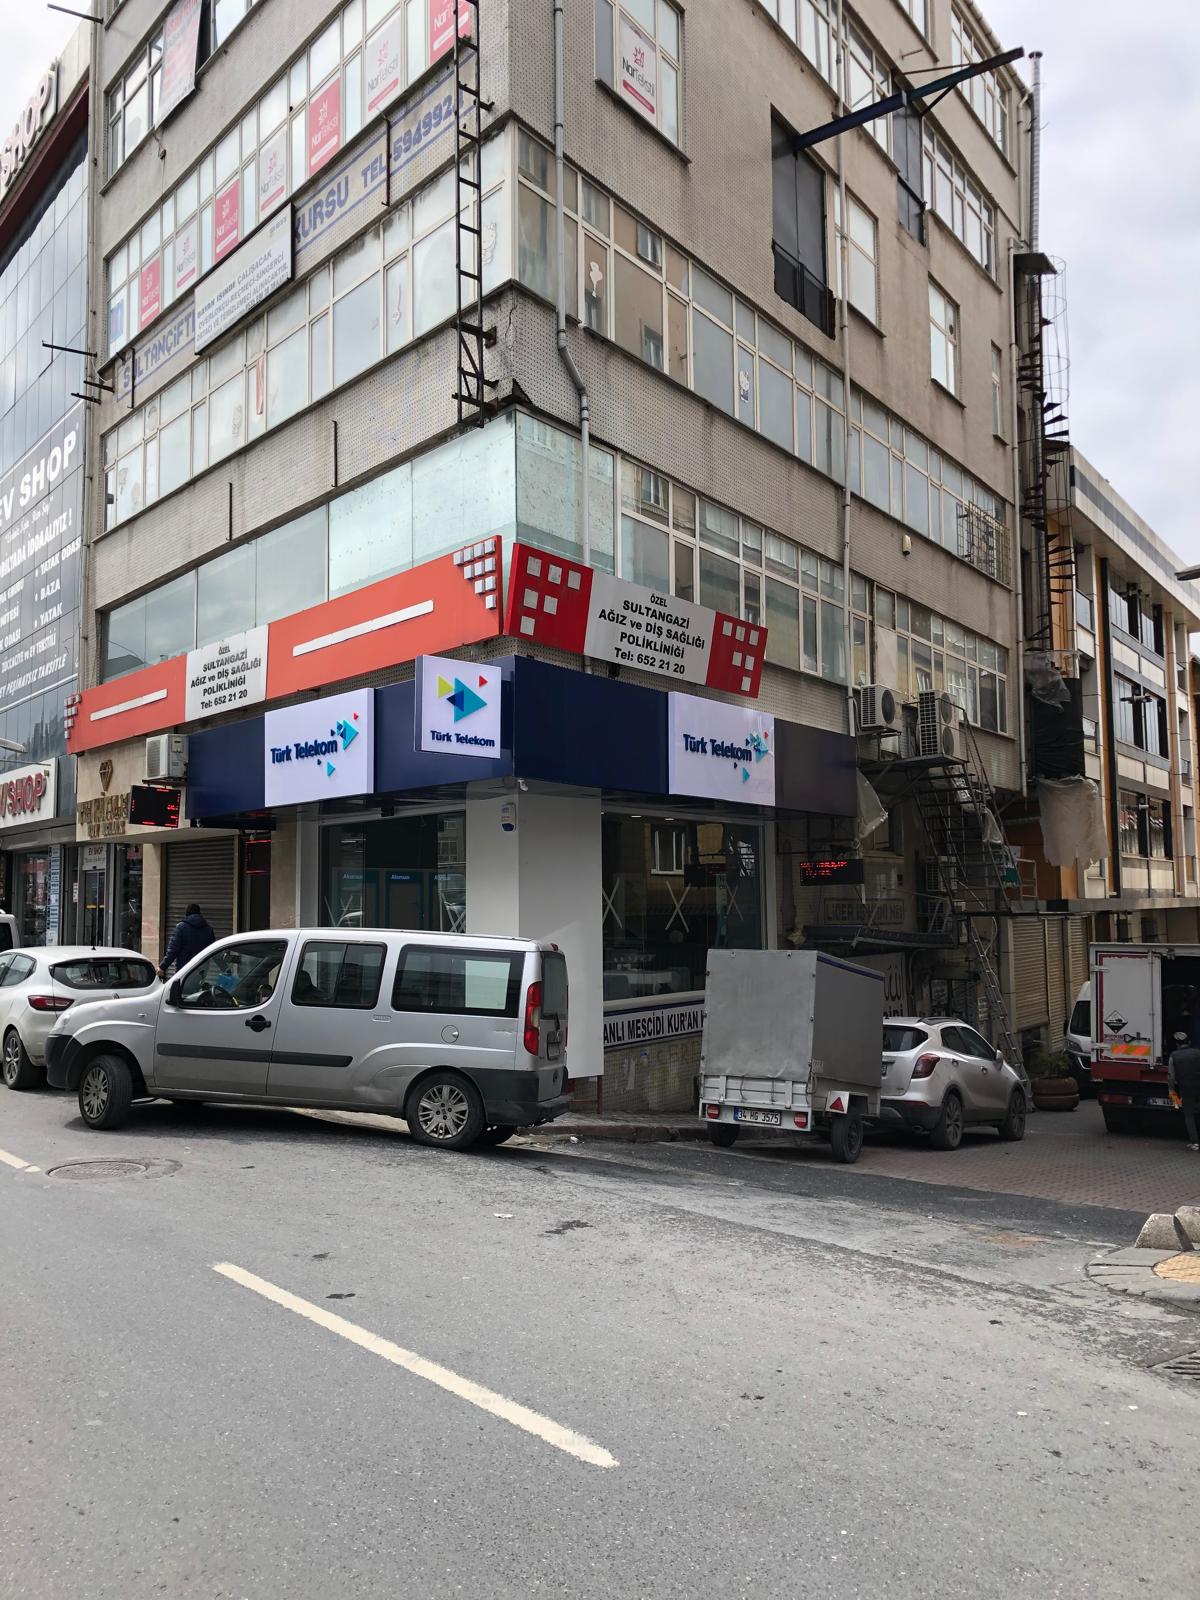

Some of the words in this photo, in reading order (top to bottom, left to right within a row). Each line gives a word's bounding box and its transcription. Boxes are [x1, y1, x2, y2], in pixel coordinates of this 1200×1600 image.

[621, 56, 655, 97] NarTekstil
[0, 487, 14, 528] V
[20, 430, 76, 507] SHOP
[40, 578, 60, 600] BAZA
[649, 593, 667, 607] ÖZEL
[40, 602, 63, 627] YATAK
[623, 600, 689, 629] SULTANGAZİ
[599, 609, 627, 626] AĞIZ
[630, 620, 642, 630] ve
[645, 622, 663, 638] DİŞ
[666, 629, 705, 649] SAĞLIĞI
[218, 645, 230, 655] ÖZEL
[620, 632, 684, 659] POLİKLİNİĞİ
[191, 676, 206, 688] AĞIZ
[217, 667, 229, 680] DİŞ
[231, 655, 261, 675] SAĞLIĞI
[203, 648, 247, 672] SULTANGAZİ
[614, 647, 633, 661] Tel:
[637, 653, 656, 667] 652
[658, 660, 670, 671] 21
[673, 663, 685, 674] 20
[203, 675, 245, 696] POLİKLİNİĞİ
[201, 700, 212, 710] Tel:
[214, 695, 226, 706] 652
[228, 692, 236, 702] 21
[238, 689, 248, 699] 20
[270, 745, 292, 764] Türk
[294, 739, 338, 760] Telekom
[430, 730, 452, 742] Türk
[455, 733, 495, 747] Telekom
[683, 734, 707, 754] Türk
[710, 738, 752, 762] Telekom
[8, 774, 46, 816] SHOP
[604, 1020, 624, 1044] ANLI
[628, 1011, 664, 1041] MESCİDİ
[667, 1010, 698, 1034] KUR'AN
[738, 1110, 747, 1119] 34
[762, 1112, 779, 1123] 3575
